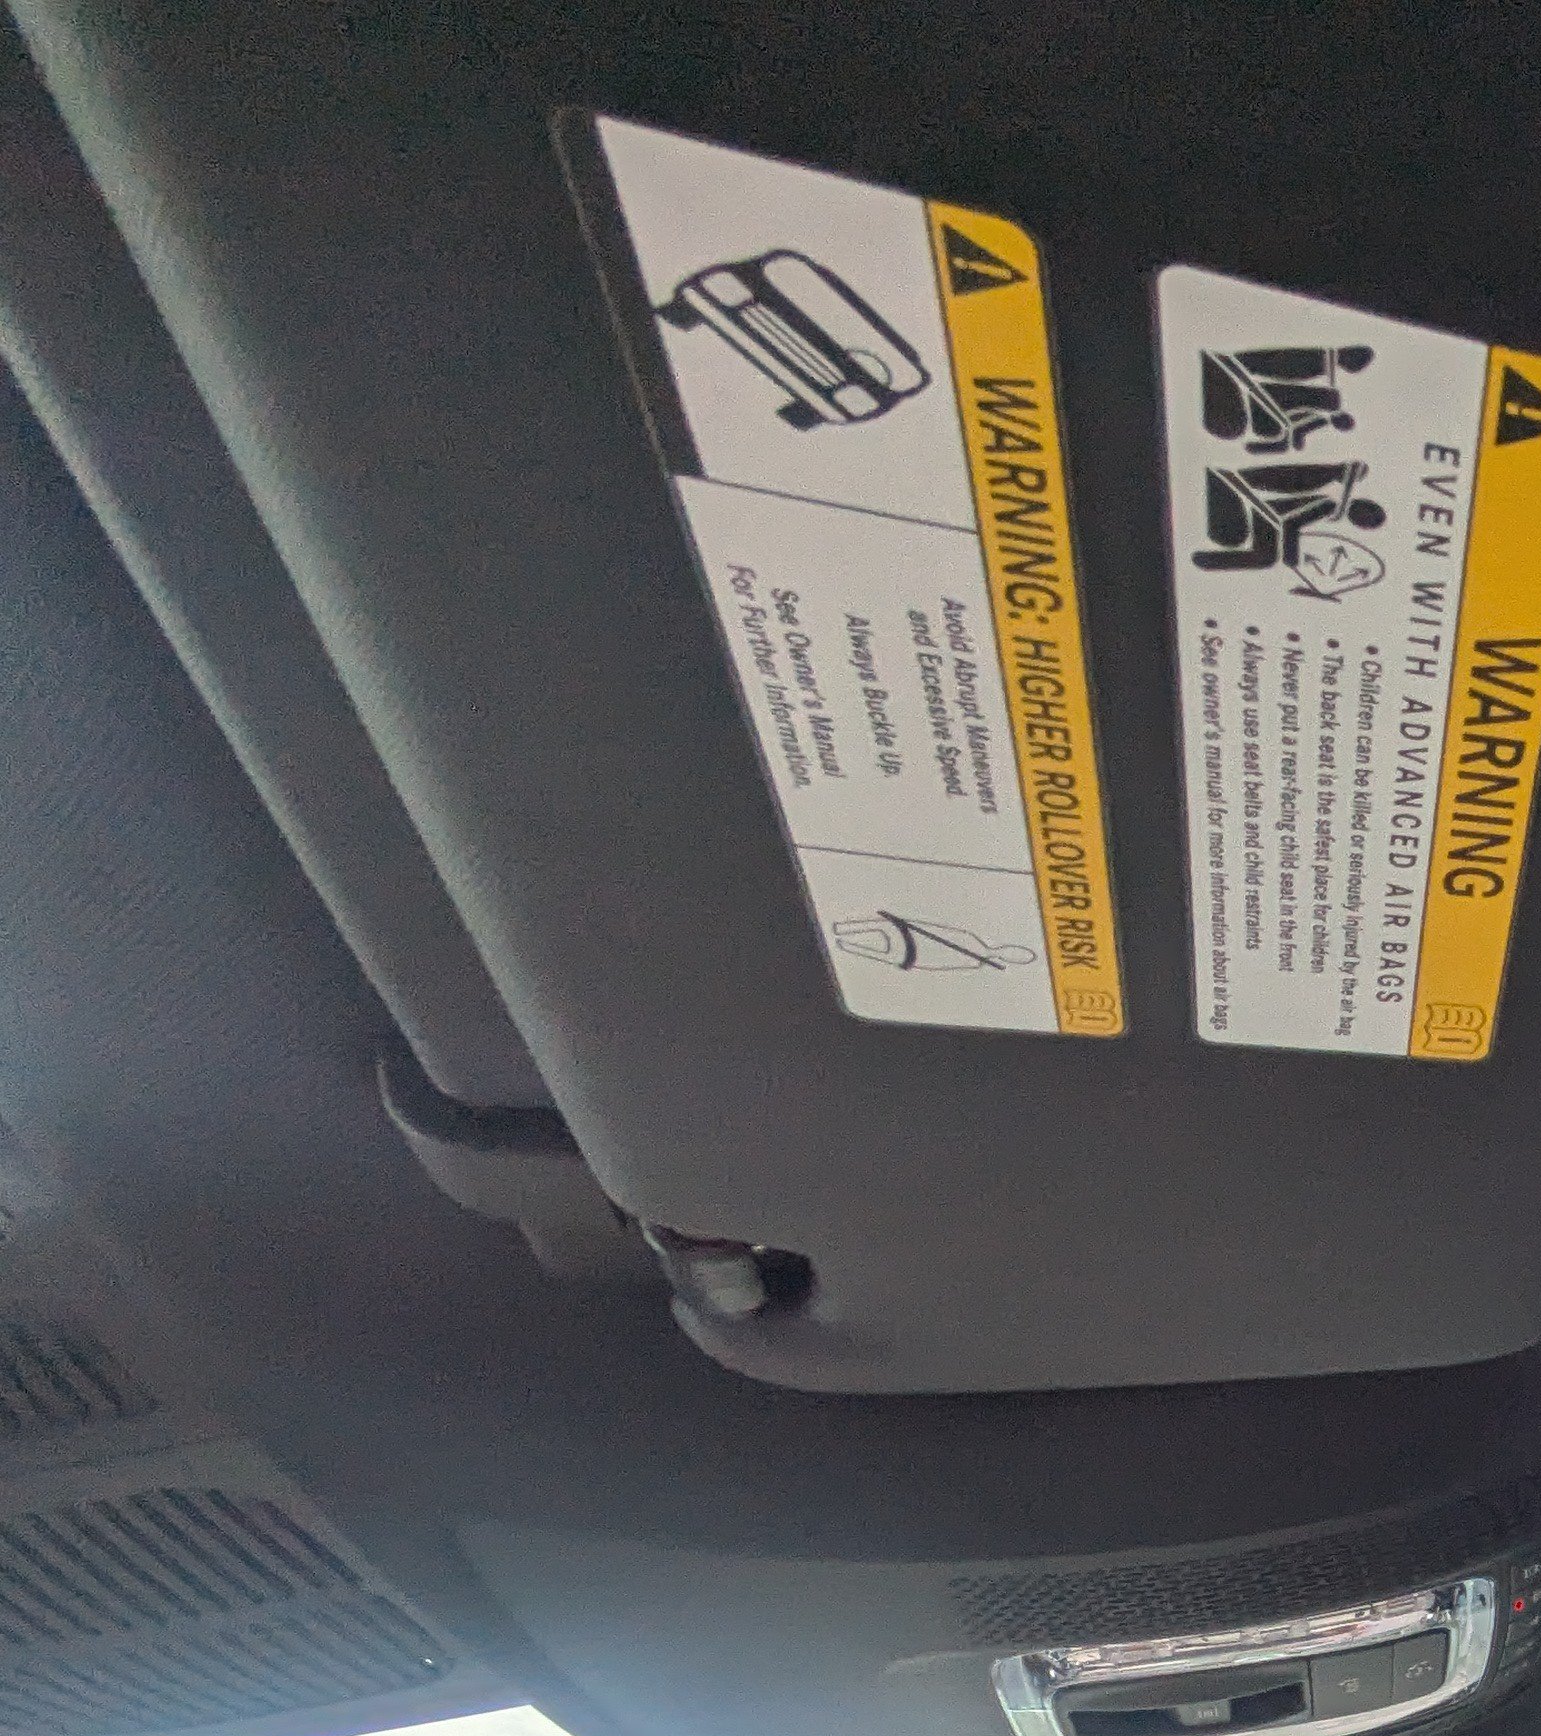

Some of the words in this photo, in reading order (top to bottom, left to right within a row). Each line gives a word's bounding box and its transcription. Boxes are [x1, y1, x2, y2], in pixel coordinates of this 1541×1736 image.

[973, 377, 1064, 624] WARNING:
[1415, 442, 1461, 557] EVEN
[726, 564, 758, 601] For
[770, 588, 801, 626] See
[941, 596, 974, 653] Avoid
[739, 605, 780, 679] Further
[846, 614, 879, 680] Always
[907, 610, 939, 648] and
[1404, 581, 1447, 678] WITH
[1201, 634, 1224, 667] See
[784, 632, 827, 709] Owner's
[953, 658, 986, 720] Abrupt
[1238, 640, 1267, 702] Always
[1281, 647, 1306, 701] Never
[1321, 655, 1345, 685] The
[917, 652, 954, 740] Excessive
[1013, 635, 1073, 761] HIGHER
[1202, 672, 1227, 740] owner's
[1320, 691, 1342, 730] back
[1358, 660, 1383, 731] Children
[863, 687, 898, 747] Buckle
[1243, 708, 1260, 738] use
[1277, 703, 1301, 732] put
[808, 715, 847, 778] Manual
[1244, 742, 1264, 777] seat
[1281, 736, 1298, 746] a
[1318, 735, 1337, 769] seat
[1355, 736, 1373, 764] can
[875, 752, 903, 778] Up.
[964, 724, 998, 814] Maneuvers
[1205, 744, 1228, 804] manual
[1318, 773, 1338, 787] is
[1354, 768, 1374, 787] be
[1389, 696, 1433, 869] ADVANCED
[1244, 781, 1266, 818] belts
[1275, 751, 1303, 832] rear-facing
[1317, 791, 1337, 815] the
[1206, 806, 1229, 828] for
[1351, 791, 1373, 831] killed
[1032, 769, 1092, 910] ROLLOVER
[1209, 832, 1225, 868] more
[1244, 822, 1265, 849] and
[1280, 835, 1300, 869] child
[1314, 818, 1336, 862] safest
[1350, 834, 1367, 849] or
[1245, 851, 1266, 886] child
[1279, 872, 1298, 901] seat
[1311, 865, 1334, 901] place
[1341, 852, 1369, 913] seriously
[1209, 872, 1231, 946] information
[1245, 889, 1264, 950] restraints
[1279, 903, 1299, 916] in
[1312, 904, 1333, 922] for
[1382, 883, 1414, 928] AIR
[1054, 917, 1100, 970] RISK
[1279, 919, 1298, 940] the
[1341, 915, 1364, 958] injured
[1211, 949, 1231, 983] about
[1279, 943, 1298, 972] front
[1310, 924, 1330, 974] children
[1339, 960, 1360, 975] by
[1341, 977, 1360, 996] the
[1375, 941, 1408, 1003] BAGS
[1212, 986, 1230, 1001] air
[1341, 998, 1358, 1013] air
[1209, 1004, 1230, 1030] bags
[1334, 1016, 1356, 1036] bag
